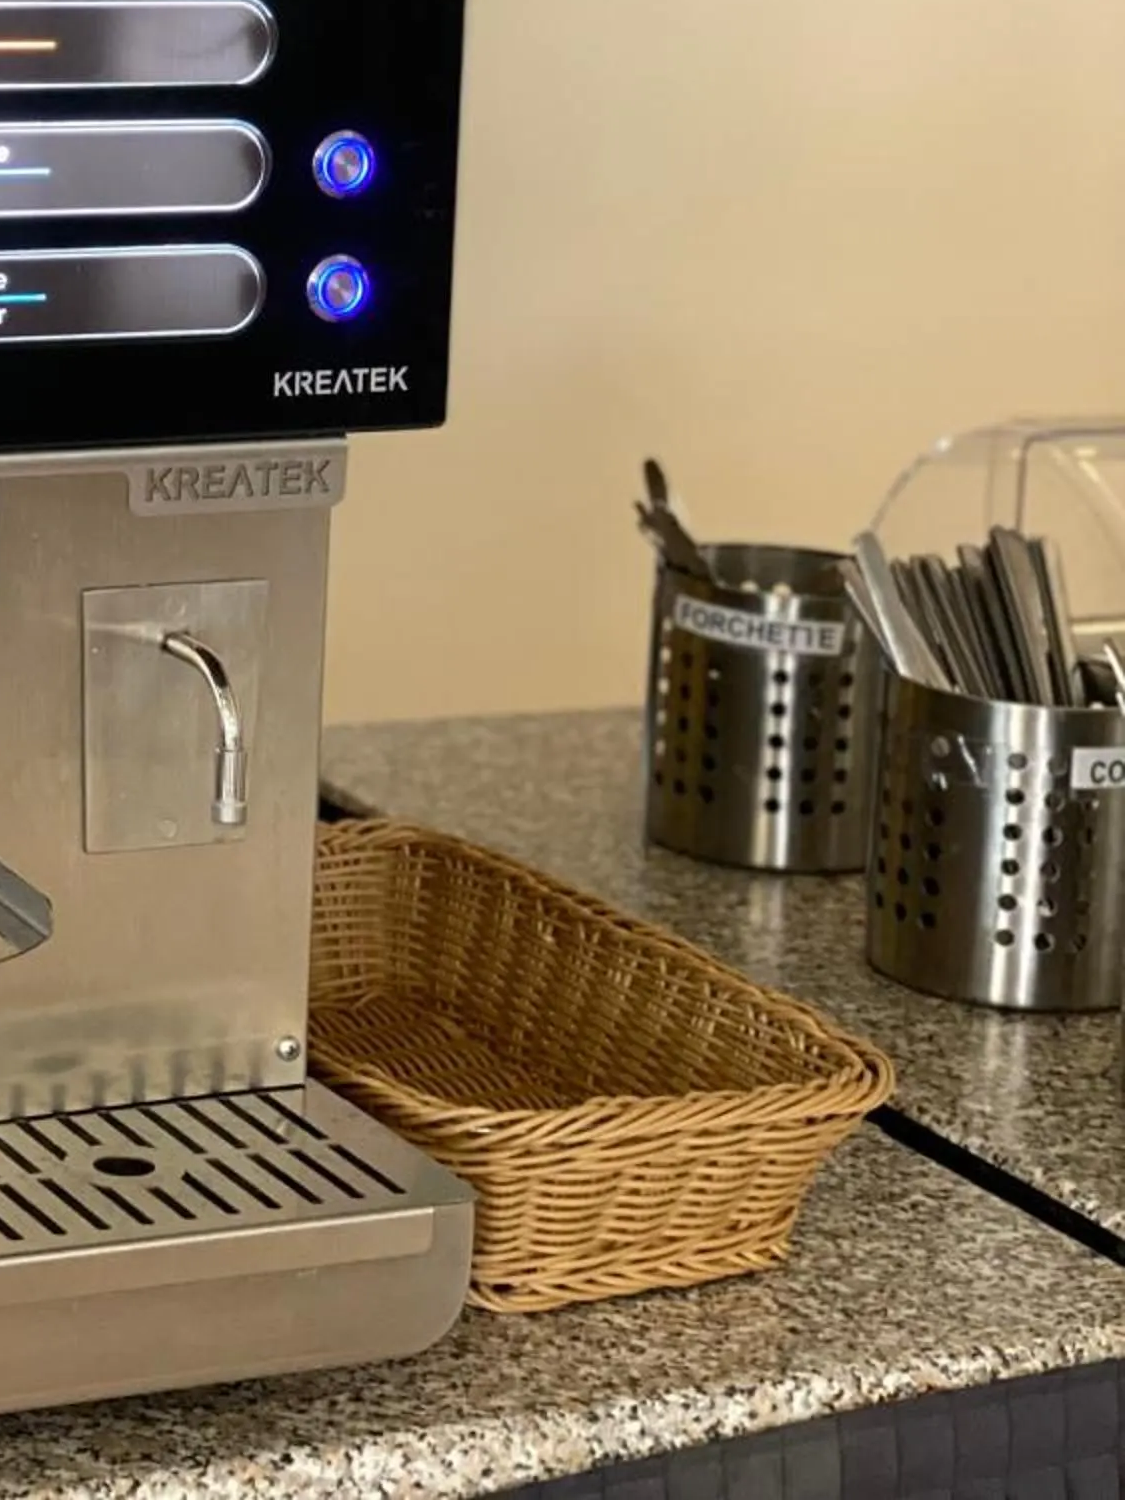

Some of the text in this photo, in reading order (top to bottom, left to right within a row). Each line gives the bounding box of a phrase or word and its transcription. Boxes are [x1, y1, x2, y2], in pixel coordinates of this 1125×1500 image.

[273, 365, 409, 398] KREATEK
[144, 458, 332, 504] KREATEK
[681, 602, 836, 650] FORCHETTE
